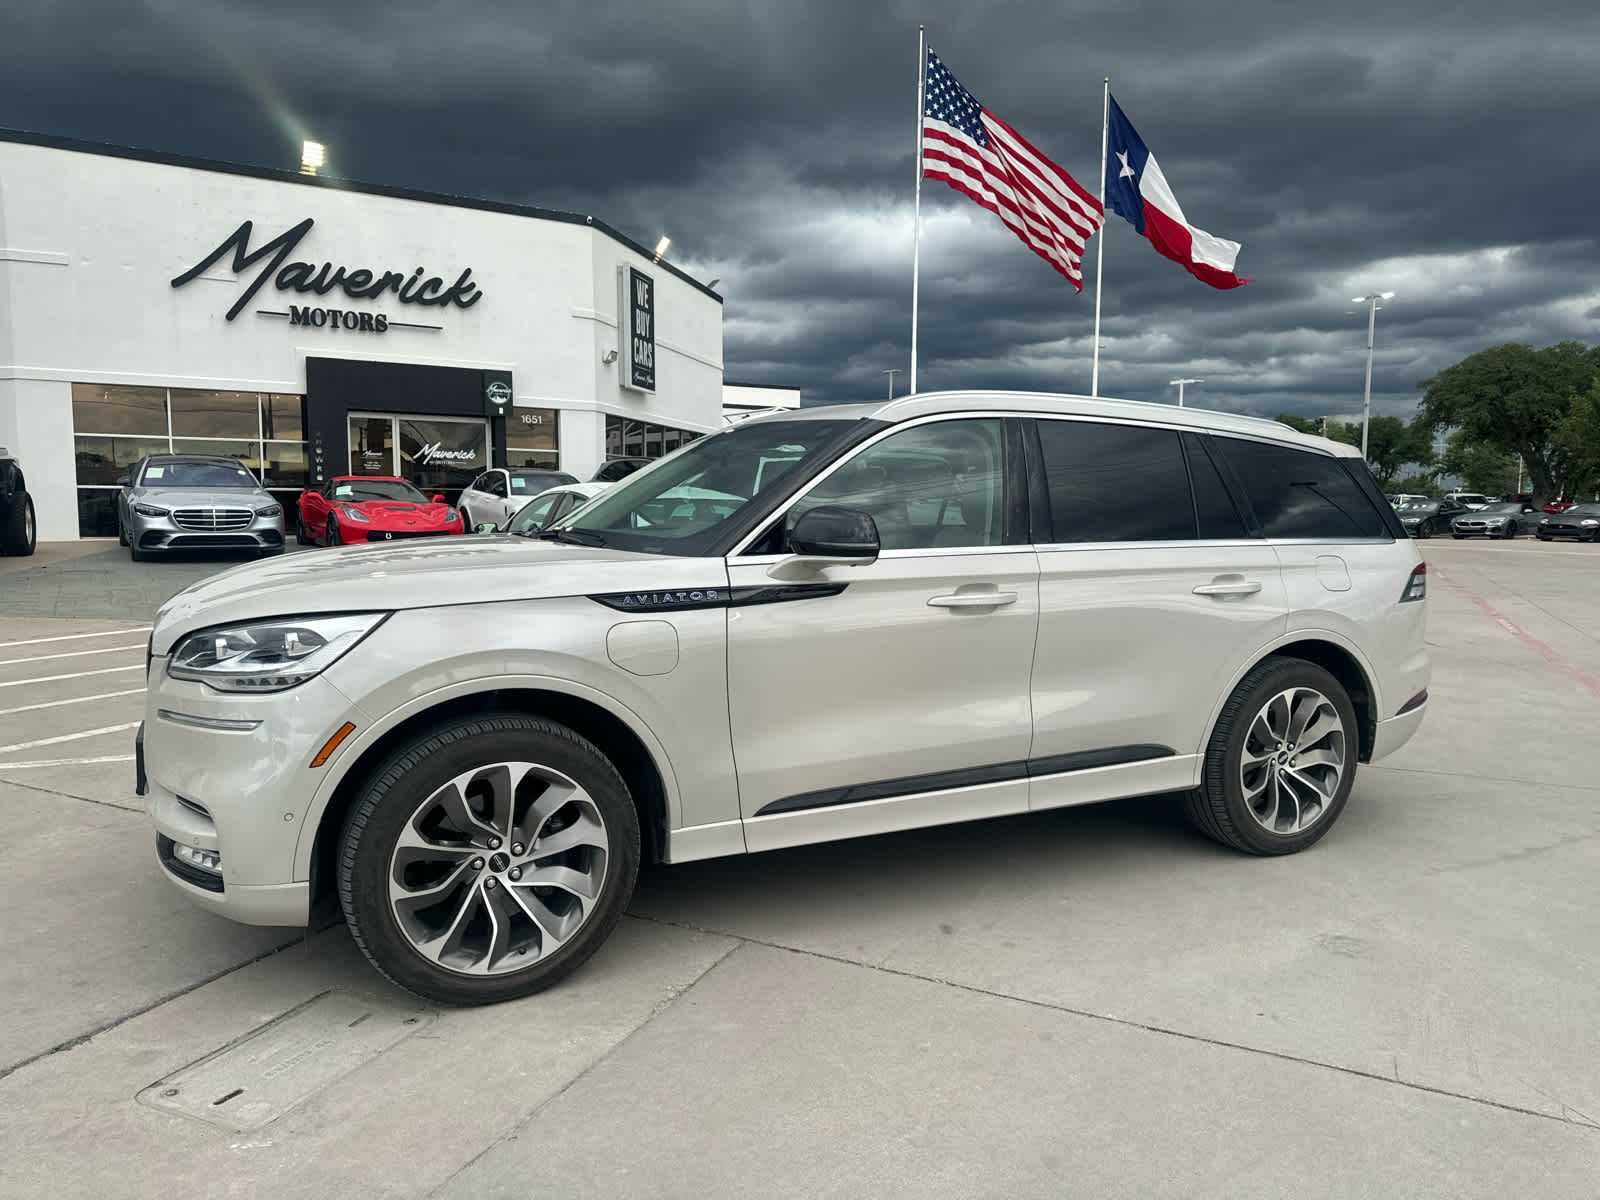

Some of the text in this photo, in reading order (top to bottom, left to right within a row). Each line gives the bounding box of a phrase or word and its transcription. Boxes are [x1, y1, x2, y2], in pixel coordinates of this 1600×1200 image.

[171, 217, 482, 321] Maverick
[636, 279, 649, 309] WE
[289, 305, 388, 332] MOTORS
[636, 308, 650, 338] BUY
[634, 337, 652, 368] CARS
[520, 414, 542, 425] 1651
[412, 441, 476, 465] Maverick
[622, 590, 719, 606] AVIATOR
